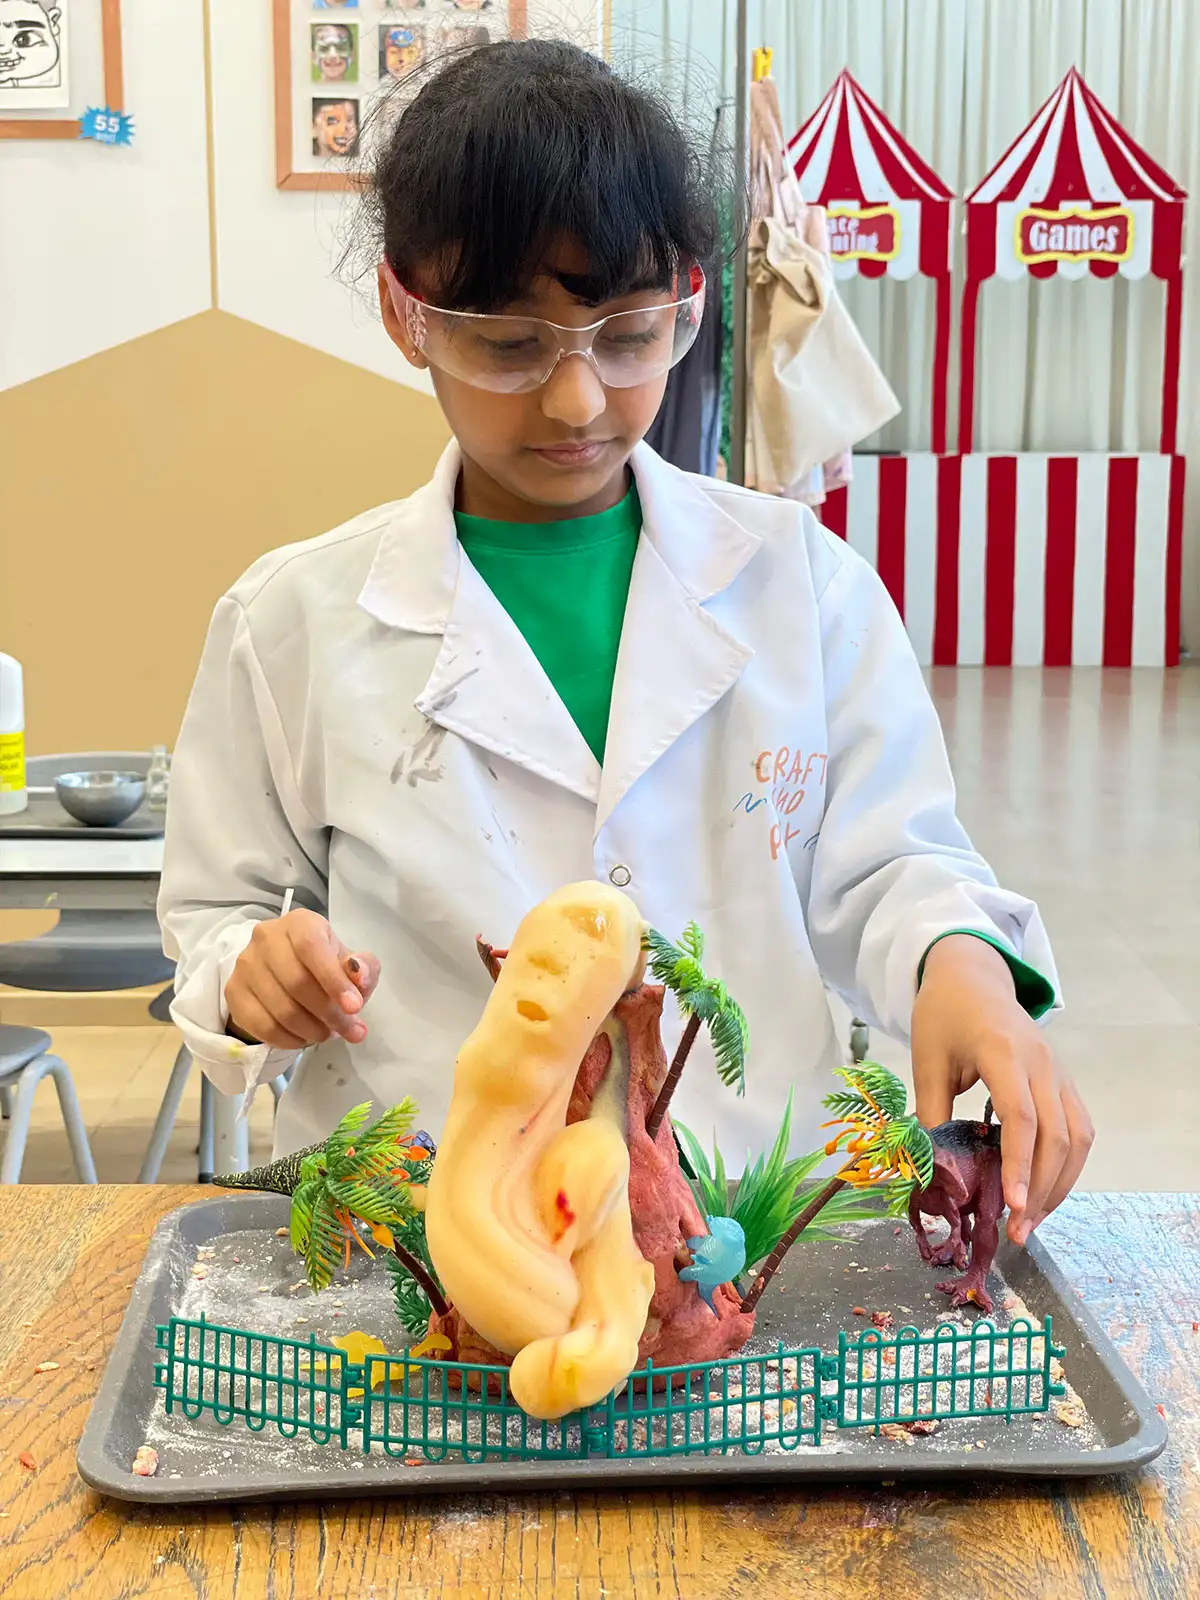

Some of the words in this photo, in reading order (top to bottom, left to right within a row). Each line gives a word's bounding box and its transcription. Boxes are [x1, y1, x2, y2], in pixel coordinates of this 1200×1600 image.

[95, 114, 120, 133] 55
[827, 216, 860, 234] ace
[1029, 220, 1119, 252] Games
[755, 746, 828, 785] CRAFT
